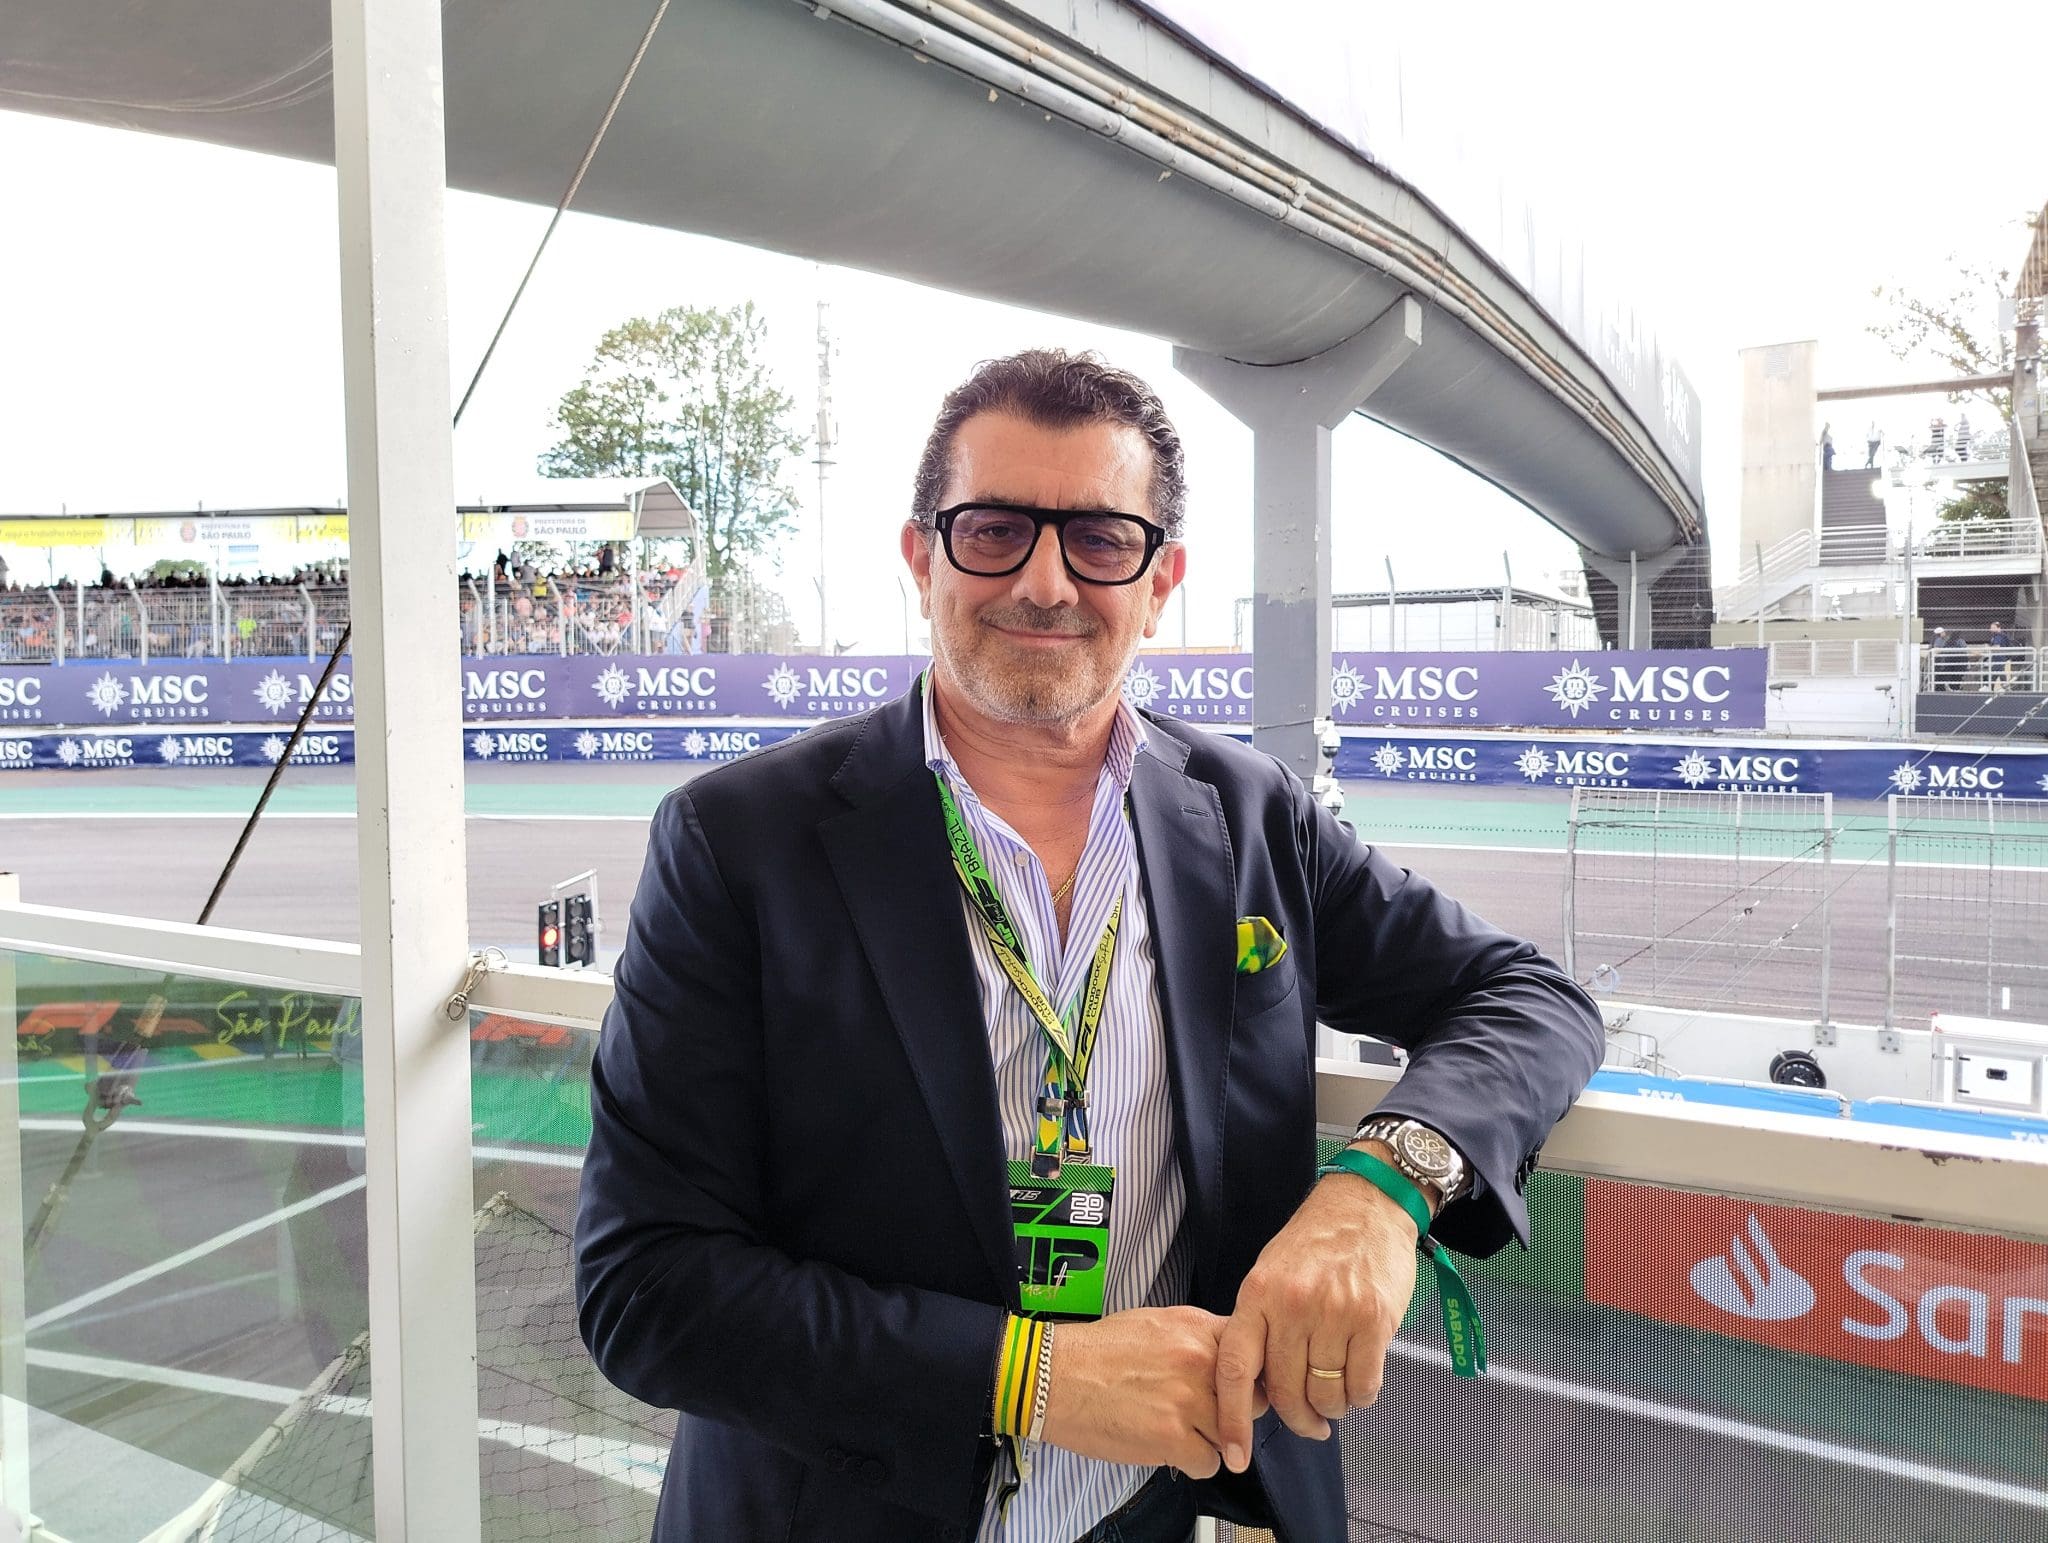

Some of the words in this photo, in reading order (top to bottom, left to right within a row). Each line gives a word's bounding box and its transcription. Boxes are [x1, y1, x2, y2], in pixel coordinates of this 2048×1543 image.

[201, 530, 220, 540] SÃO
[222, 530, 252, 540] PAULO
[534, 526, 554, 535] SÃO
[556, 526, 587, 535] PAULO
[130, 675, 208, 704] MSC
[298, 673, 355, 703] MS
[466, 670, 546, 700] MSC
[636, 667, 716, 697] MSC
[807, 667, 888, 697] MSC
[1168, 667, 1253, 700] MSC
[1374, 666, 1479, 698] MSC
[1610, 665, 1730, 703] MSC
[131, 707, 209, 718] CRUISES
[466, 702, 547, 713] CRUISES
[637, 699, 717, 711] CRUISES
[1374, 705, 1479, 718] CRUISES
[1610, 708, 1730, 721] CRUISES
[0, 741, 33, 760] SC
[82, 738, 133, 759] MSC
[183, 736, 233, 757] MSC
[496, 732, 547, 752] MSC
[601, 731, 653, 752] MSC
[709, 732, 760, 752] MSC
[1407, 746, 1476, 770] MSC
[1554, 750, 1629, 776] MSC
[1717, 754, 1799, 783] MSC
[1408, 772, 1477, 782] CRUISES
[1554, 776, 1629, 788] CRUISES
[1928, 764, 2004, 790] MSC
[950, 819, 979, 873] BRAZIL
[1015, 977, 1054, 1026] PADDOCK
[1085, 962, 1102, 1018] PADDOCK
[1090, 988, 1102, 1018] CLUB
[277, 992, 363, 1048] Paul
[1035, 994, 1056, 1022] CLUB
[1447, 1297, 1467, 1367] SABADO
